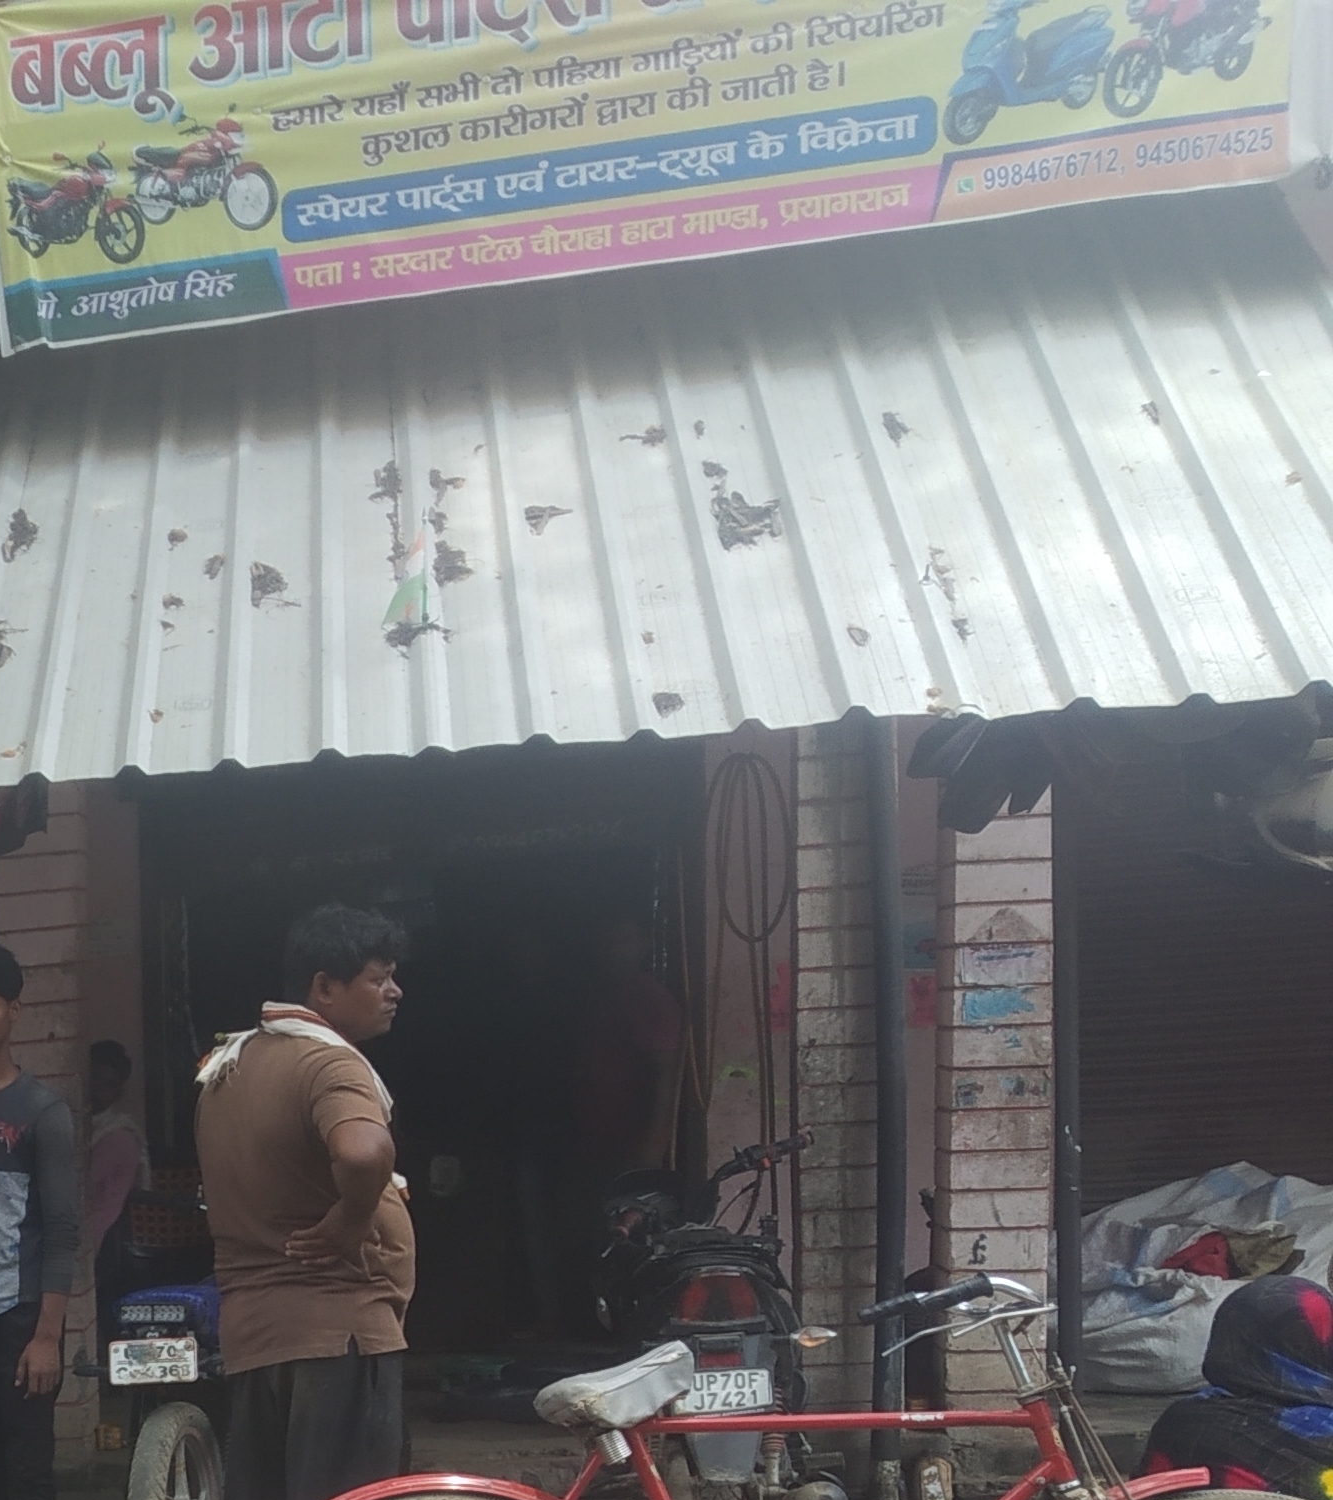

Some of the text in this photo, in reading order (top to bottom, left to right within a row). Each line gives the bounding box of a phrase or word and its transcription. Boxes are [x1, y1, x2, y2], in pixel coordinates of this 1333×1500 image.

[272, 1, 945, 131] हमारे यहाँ सभी दो पहिया गाड़ियों की रिपेयरिंग
[361, 123, 452, 167] कुशल
[459, 92, 590, 142] कारीगरों
[597, 91, 657, 126] द्वारा
[666, 76, 711, 111] की
[721, 64, 798, 102] जाती
[1135, 127, 1274, 168] 9450674525
[296, 190, 391, 226] स्पेयर
[396, 173, 487, 213] पार्ट्स
[495, 160, 550, 198] एवं
[747, 130, 788, 161] के
[798, 113, 919, 154] विक्रेता
[294, 261, 344, 289] पता
[370, 246, 454, 279] सरदार
[460, 233, 524, 266] पटेल
[530, 223, 612, 256] चौराहा
[620, 216, 675, 245] हाटा
[778, 183, 912, 224] प्रयागराज
[71, 276, 179, 320] आशुतोष
[183, 268, 238, 301] सिंह
[693, 1371, 760, 1392] UP70F
[694, 1389, 758, 1411] J7421
